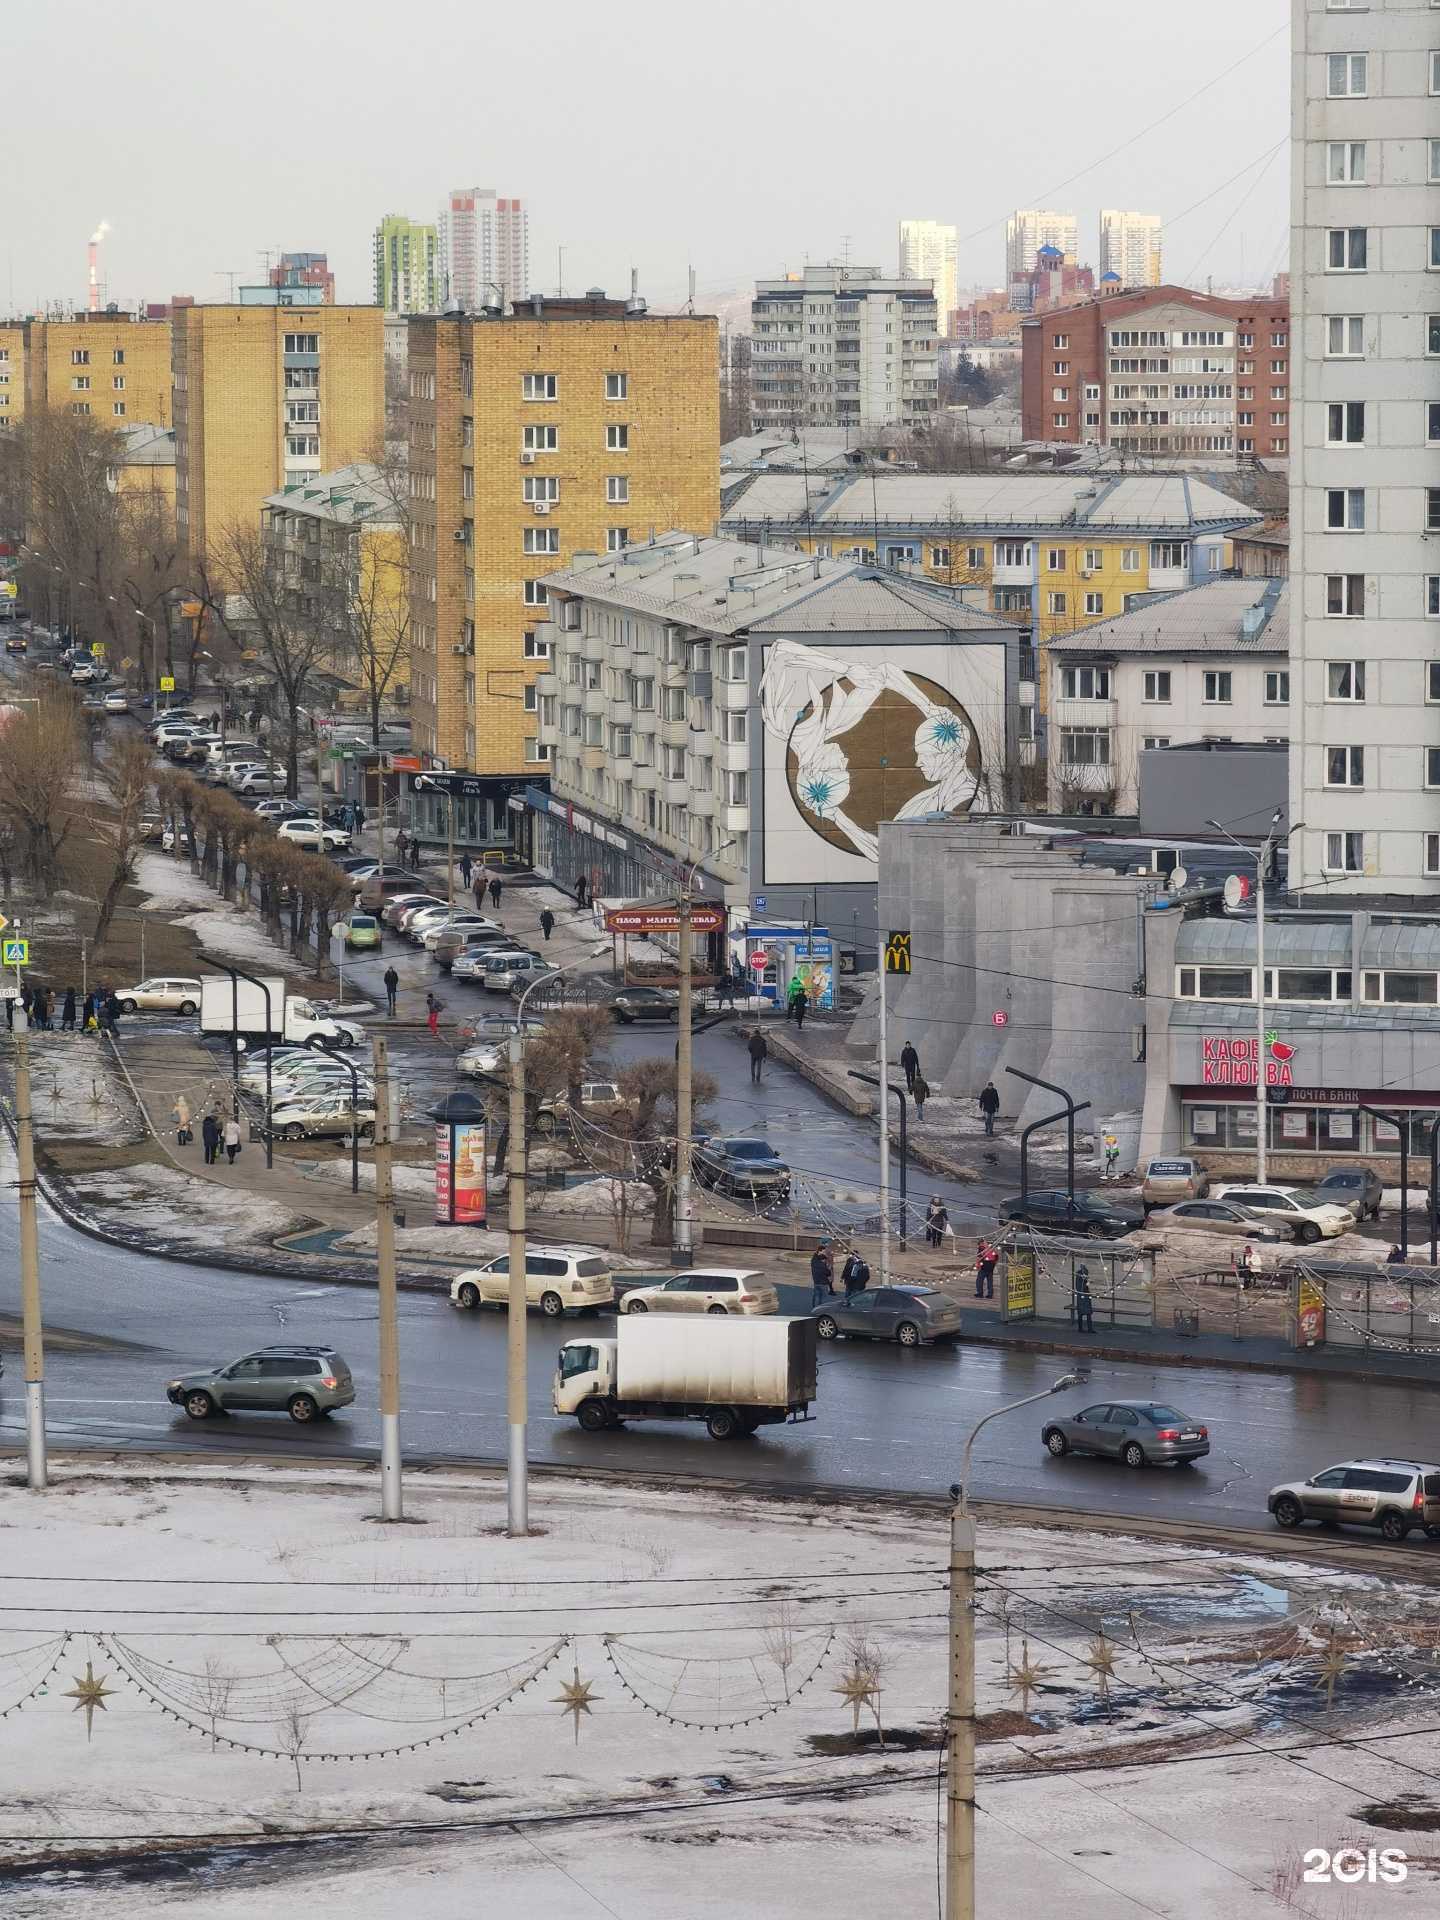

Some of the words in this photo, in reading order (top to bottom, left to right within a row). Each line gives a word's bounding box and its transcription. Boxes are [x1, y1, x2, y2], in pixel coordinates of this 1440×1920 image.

[1202, 1036, 1260, 1061] КАФЕ
[1292, 1089, 1327, 1101] ПОЧТА
[1329, 1090, 1360, 1102] БАНК
